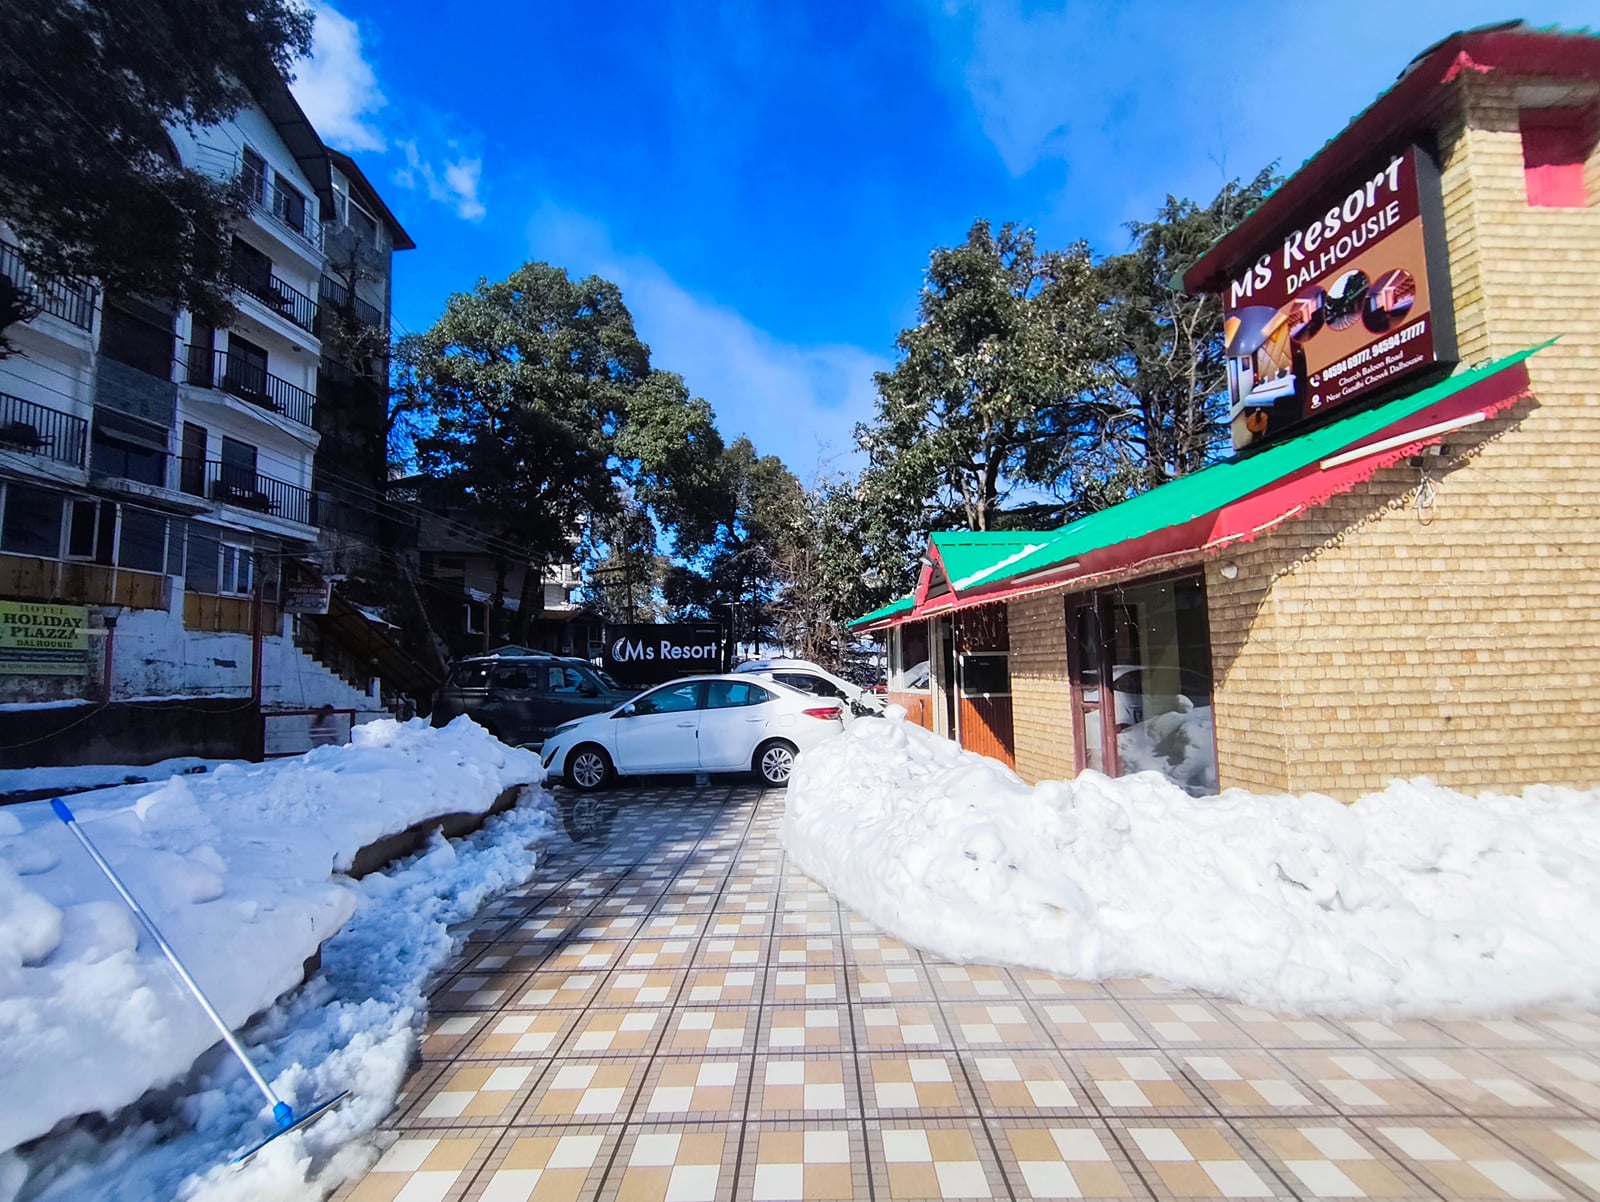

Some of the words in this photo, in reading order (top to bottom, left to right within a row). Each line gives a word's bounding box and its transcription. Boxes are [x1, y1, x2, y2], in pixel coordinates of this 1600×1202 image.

[1231, 255, 1272, 308] MS
[1284, 156, 1403, 269] Resort
[1286, 200, 1401, 294] DALHOUSIE
[1400, 320, 1425, 343] 27777
[1326, 391, 1341, 402] Near
[1342, 379, 1365, 396] Gandhi
[1365, 370, 1388, 385] Chowk
[1389, 354, 1424, 374] Dalhousie
[1339, 372, 1362, 386] Church
[1385, 350, 1404, 365] Road
[3, 613, 83, 628] HOLIDAY
[20, 604, 68, 615] HOTEL
[10, 626, 79, 639] PLAZZA
[16, 640, 73, 648] DALHOUSIE
[625, 639, 655, 661] Ms
[660, 640, 717, 660] Resort
